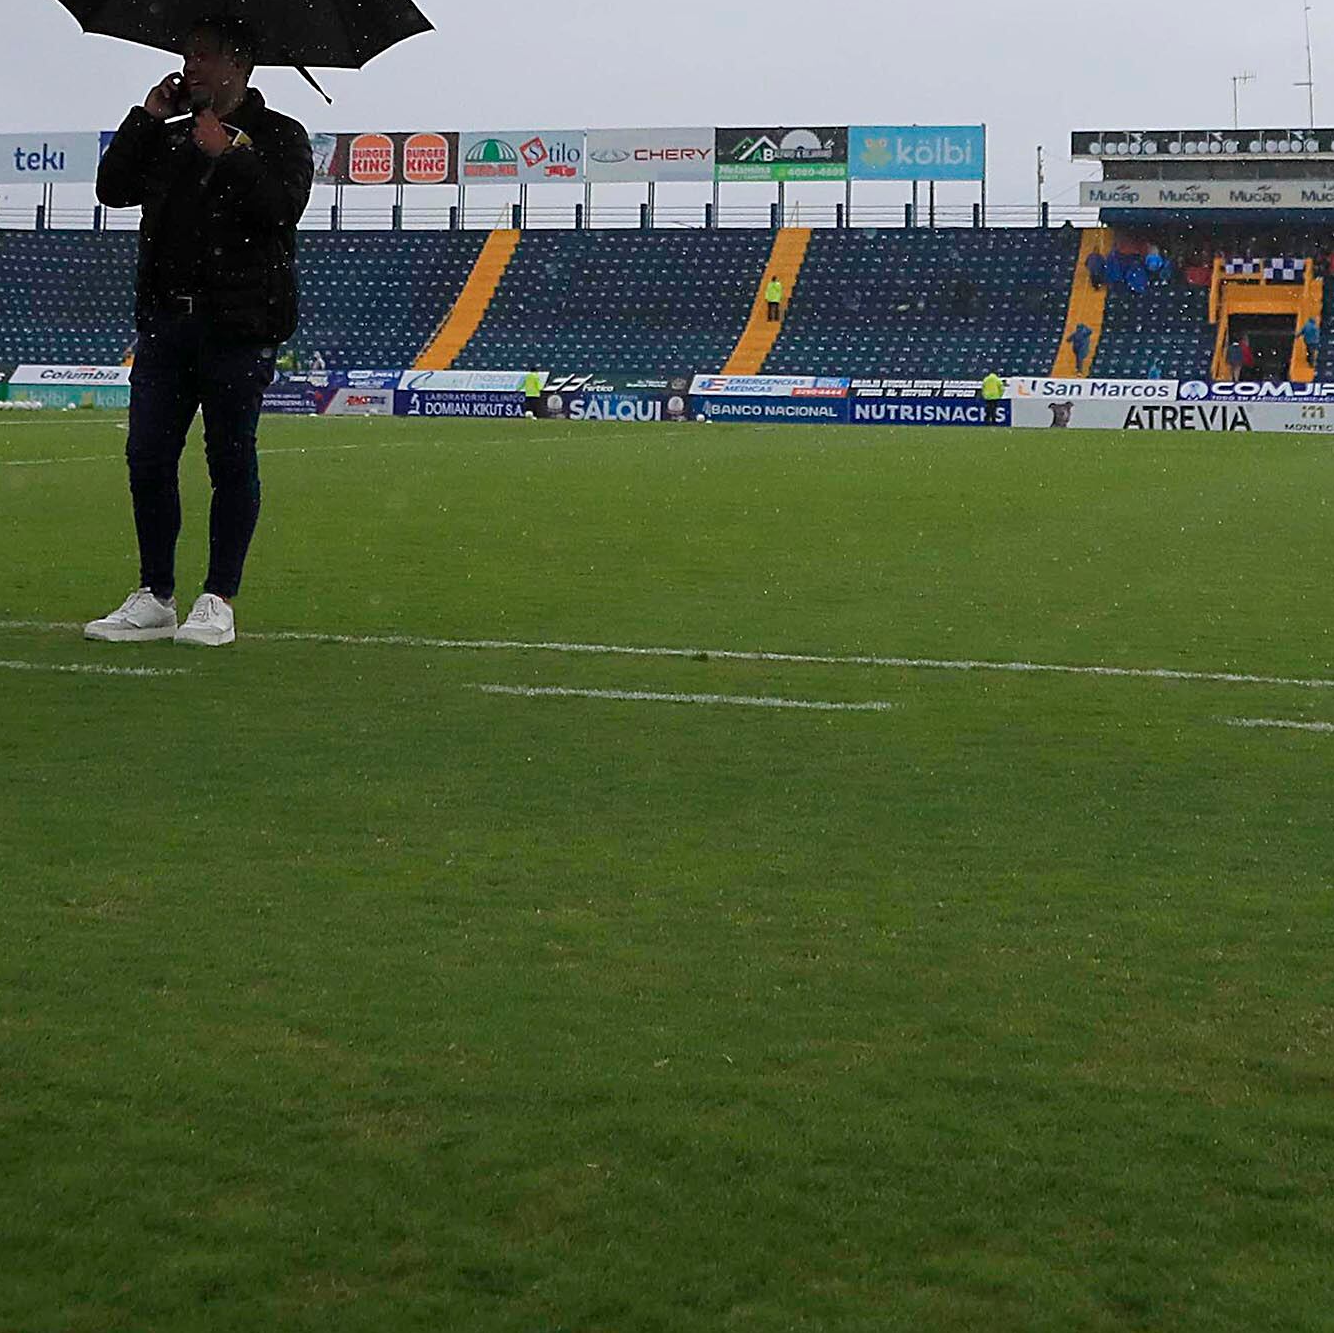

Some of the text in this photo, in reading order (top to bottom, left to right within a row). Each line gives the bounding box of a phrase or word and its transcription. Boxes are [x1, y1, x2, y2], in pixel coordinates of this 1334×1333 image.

[13, 143, 65, 171] teki
[351, 150, 392, 159] BURGER
[406, 149, 446, 158] BURGER
[633, 147, 712, 161] CHERY
[895, 138, 973, 166] kölbi
[351, 159, 392, 172] KING
[406, 158, 446, 172] KING
[1089, 190, 1140, 204] Mucap
[1159, 190, 1211, 204] Mucap
[1229, 190, 1282, 204] Mucap
[39, 369, 120, 381] Columbia
[1042, 381, 1169, 397] San Marcos
[569, 399, 662, 422] SALQUI
[711, 404, 838, 417] BANCO NACIONAL
[1122, 405, 1253, 432] ATREVIA
